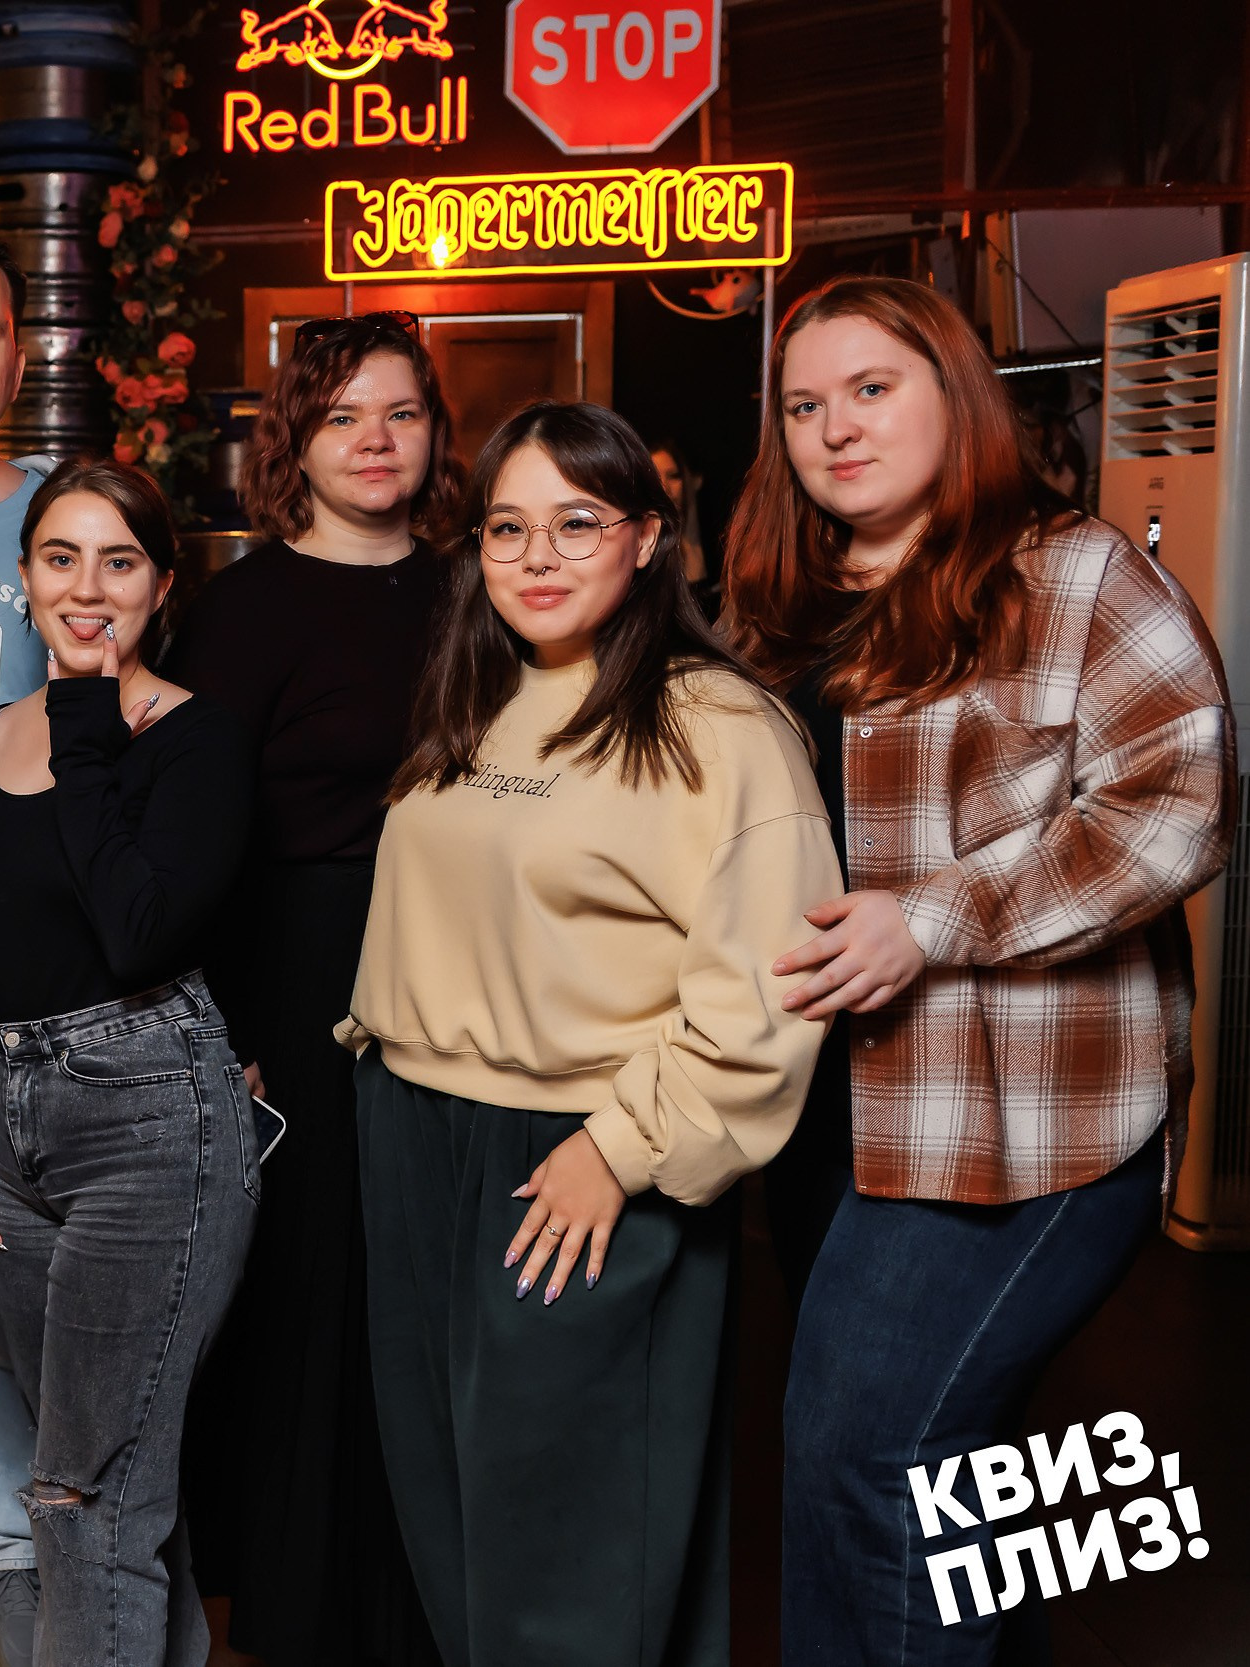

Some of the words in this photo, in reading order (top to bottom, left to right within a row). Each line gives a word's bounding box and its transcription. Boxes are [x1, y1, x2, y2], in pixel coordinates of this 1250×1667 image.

[530, 10, 703, 86] STOP
[223, 82, 340, 153] Red
[353, 76, 468, 146] Bull
[463, 763, 561, 799] ilingual.
